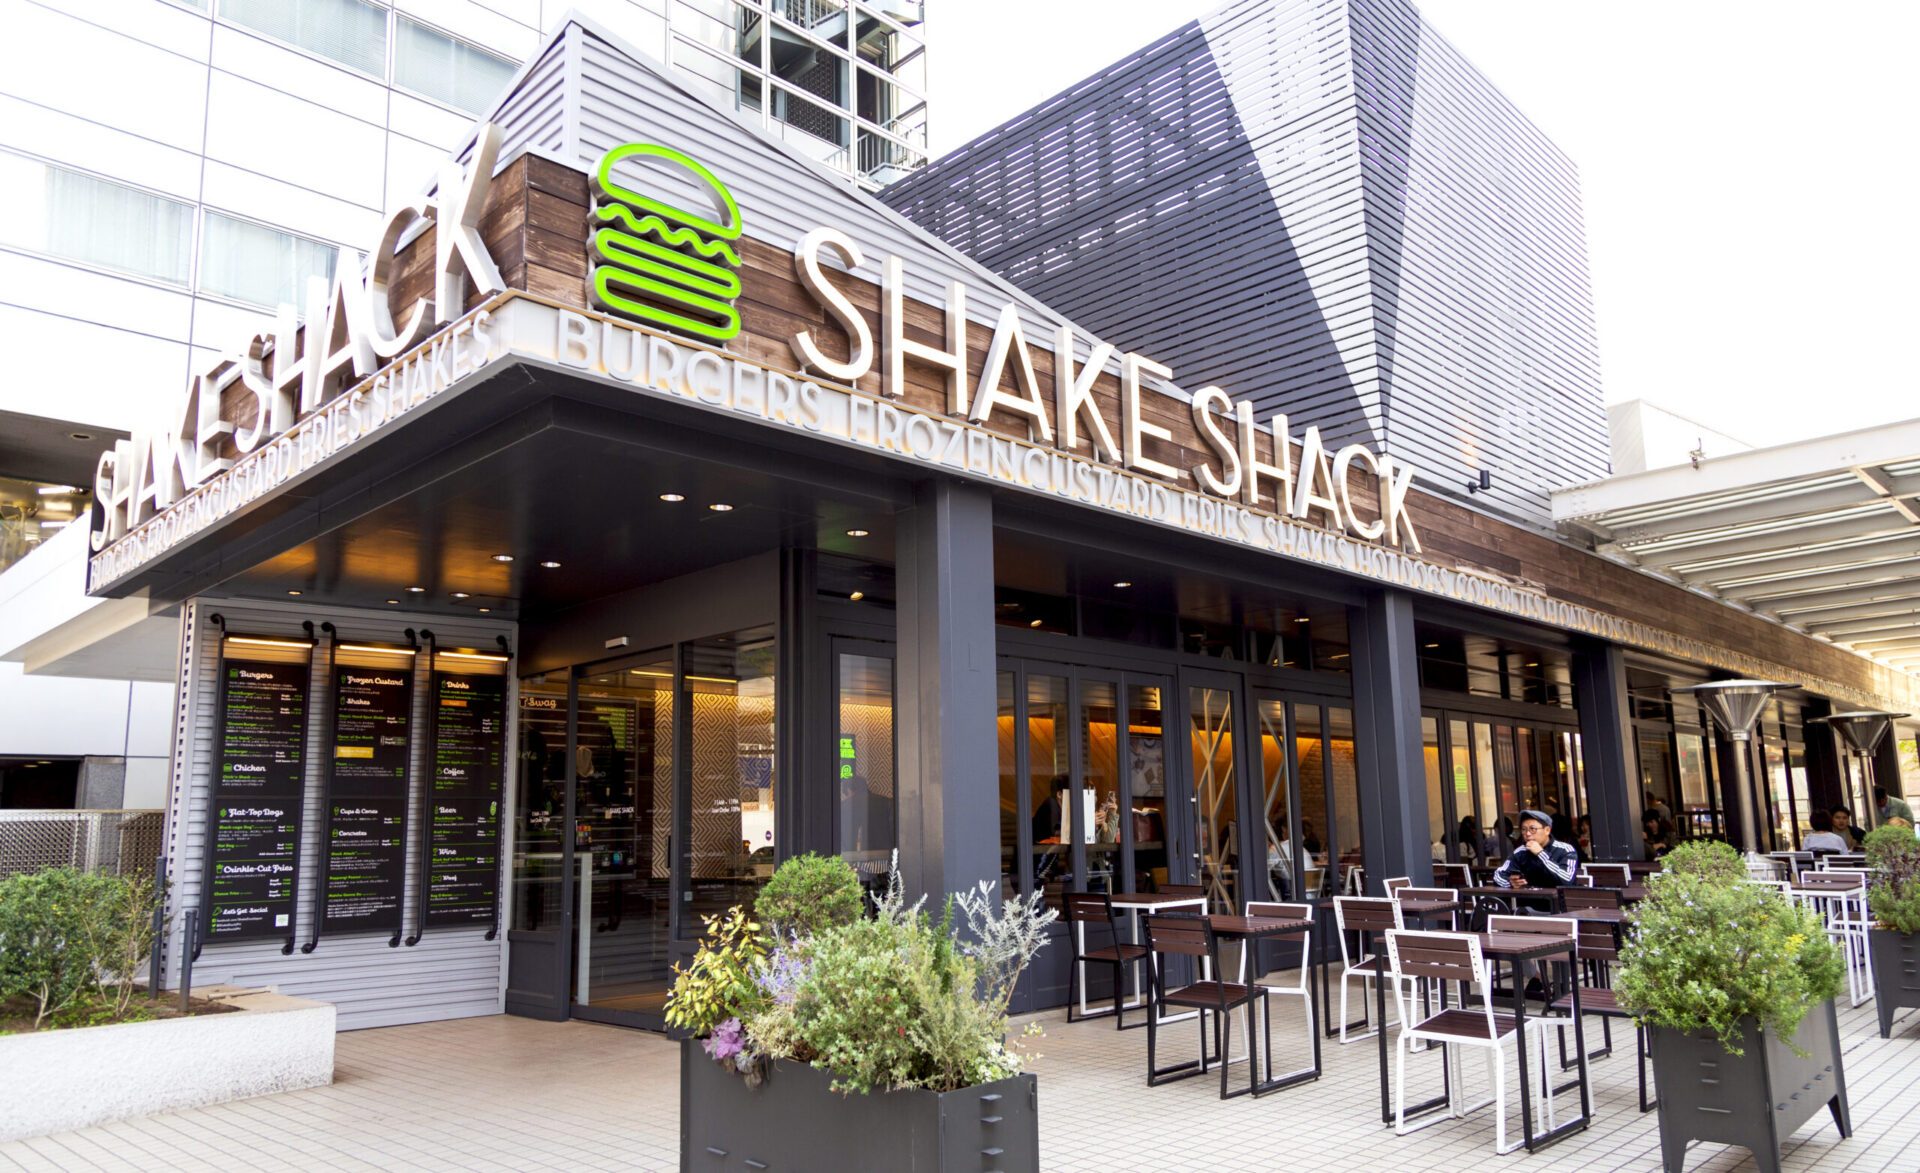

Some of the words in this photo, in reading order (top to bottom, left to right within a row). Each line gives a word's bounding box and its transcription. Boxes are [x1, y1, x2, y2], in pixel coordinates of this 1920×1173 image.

[234, 121, 506, 453] SHACK
[789, 227, 1179, 479] SHAKE
[1192, 386, 1422, 553] SHACK
[208, 437, 293, 522] CUSTARD
[299, 391, 363, 471] FRIES
[371, 310, 492, 426] SHAKES
[557, 309, 826, 431] BURGERS
[849, 394, 1016, 483] FROZEN
[1023, 448, 1169, 521] CUSTARD
[1183, 492, 1252, 544] FRIES
[1262, 516, 1347, 570] SHAKES
[1356, 543, 1398, 582] HOT
[1400, 556, 1449, 596] DOGS
[1456, 573, 1543, 619] CONCRETES
[1593, 613, 1630, 642] CONES
[239, 670, 274, 680] Burgers
[346, 675, 374, 685] Frozen
[374, 677, 404, 686] Custard
[446, 681, 470, 689] Drinks
[346, 698, 371, 706] Shakes
[528, 697, 557, 709] Swag
[233, 764, 266, 772] Chicken
[443, 767, 465, 777] Coffee
[228, 808, 262, 818] Flat-Top
[263, 808, 284, 818] Dogs
[439, 806, 457, 814] Beer
[438, 848, 457, 856] Wine
[223, 865, 272, 874] Crinkle-Cut
[272, 864, 293, 874] Fries
[236, 908, 248, 916] Get
[249, 906, 268, 914] Social
